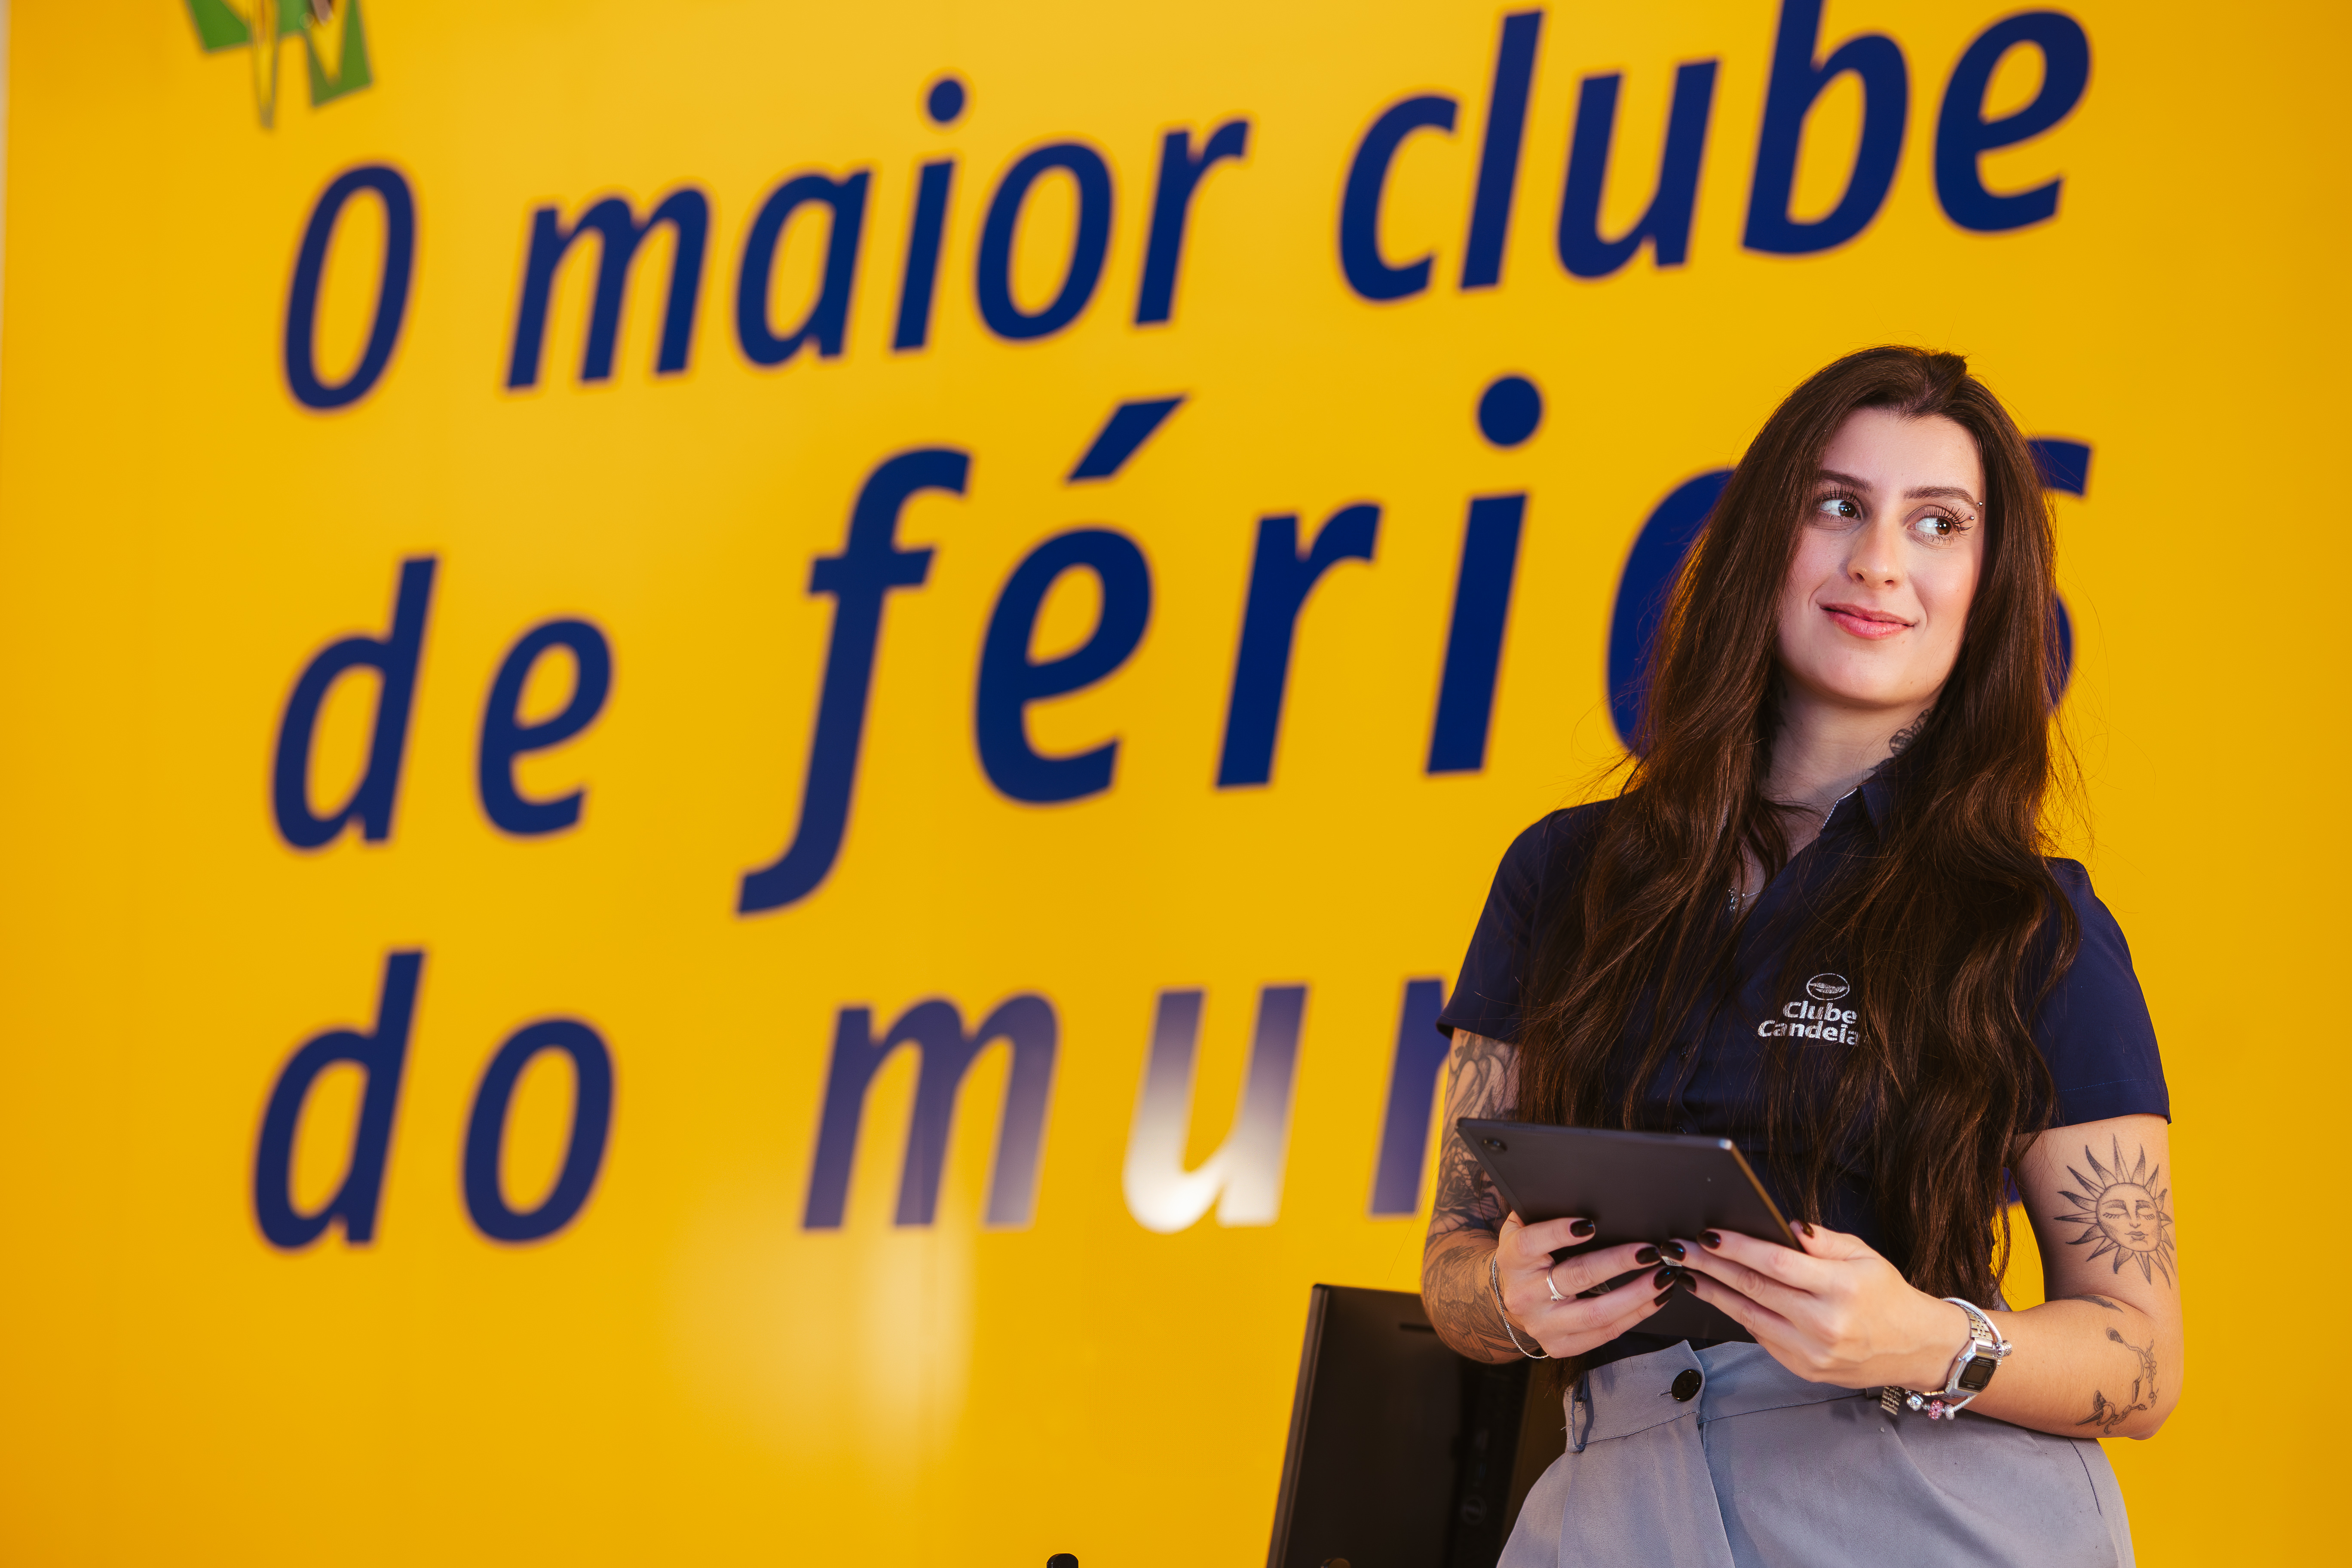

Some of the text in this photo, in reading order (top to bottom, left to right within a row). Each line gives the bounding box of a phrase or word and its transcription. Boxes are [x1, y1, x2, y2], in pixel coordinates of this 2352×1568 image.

[283, 0, 2092, 411] O maior clube
[271, 556, 613, 851] de
[252, 949, 615, 1245] do
[1758, 1020, 1868, 1046] Candeia
[1783, 1001, 1858, 1024] Clube
